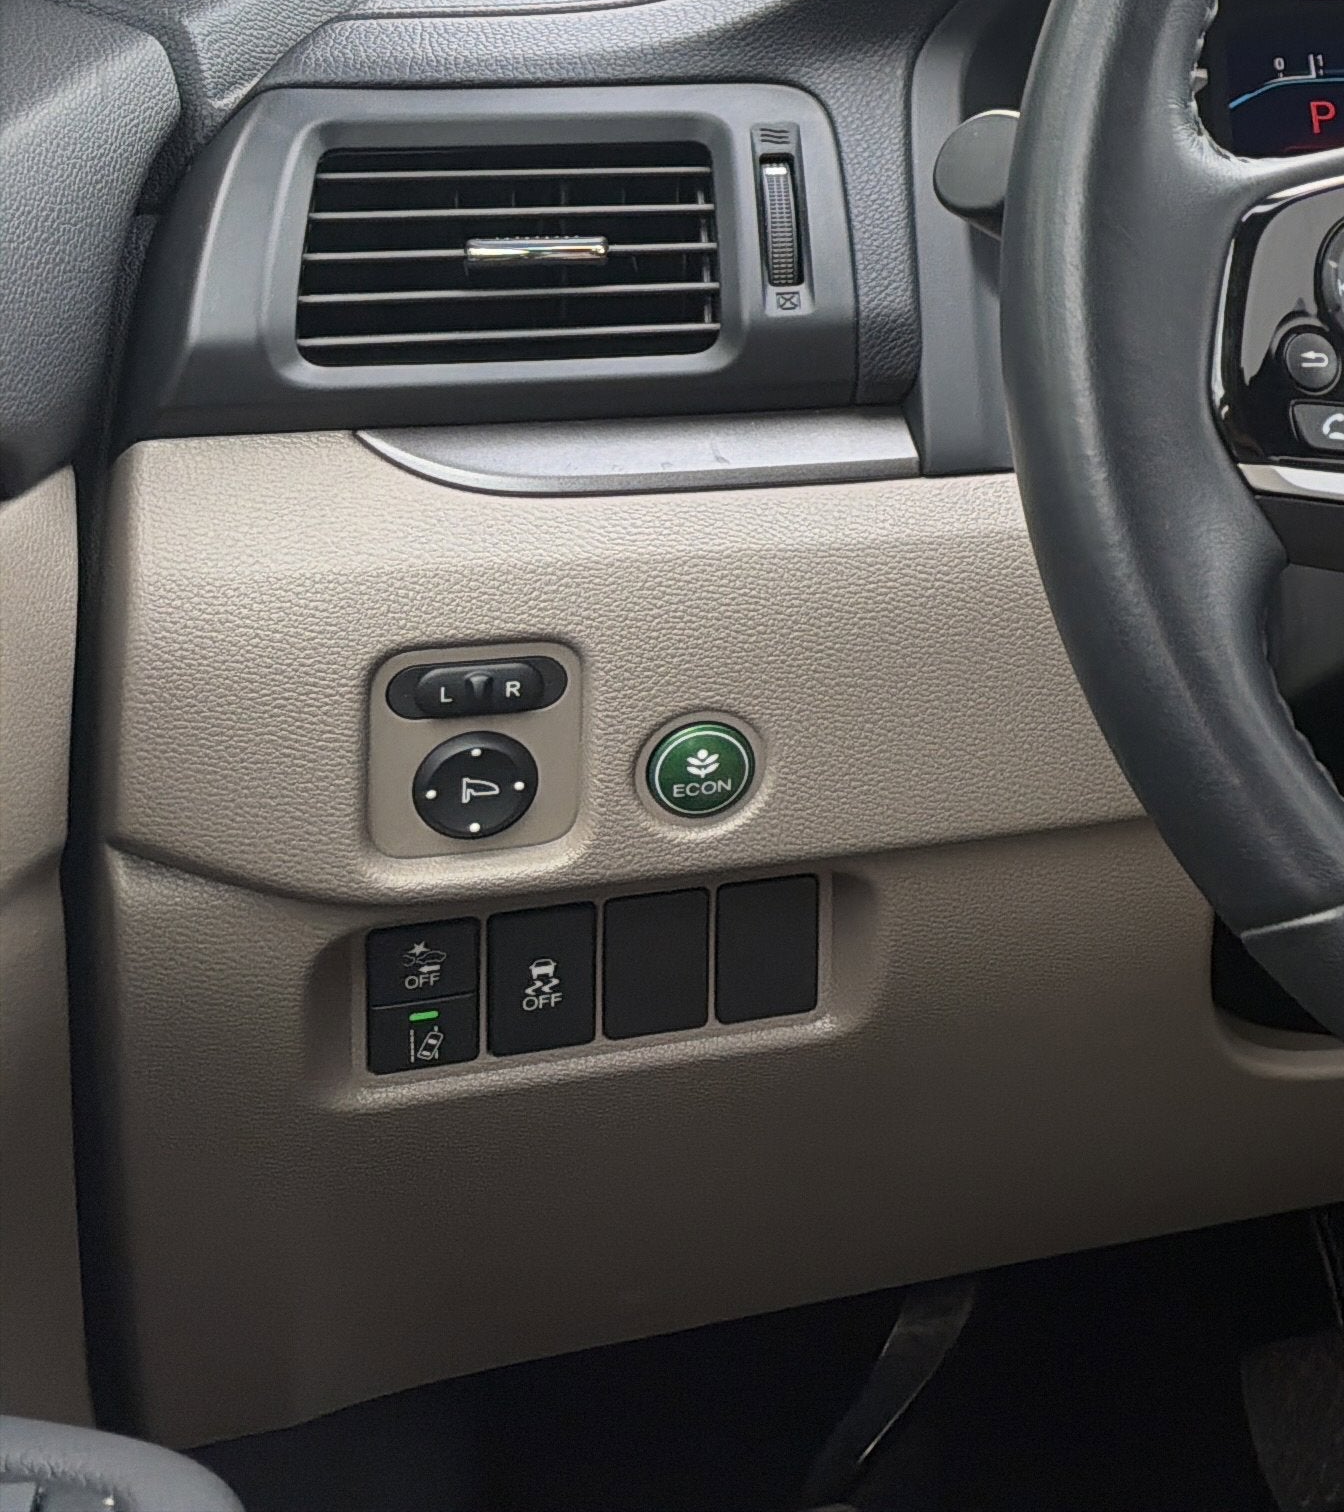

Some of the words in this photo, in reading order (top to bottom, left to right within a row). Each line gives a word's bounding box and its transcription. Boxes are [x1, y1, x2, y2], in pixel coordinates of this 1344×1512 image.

[1273, 56, 1287, 71] 0
[1316, 52, 1325, 67] 1
[1309, 99, 1337, 135] P
[440, 687, 453, 704] L
[506, 681, 522, 698] R
[672, 777, 734, 799] ECON
[404, 973, 442, 991] OFF
[522, 993, 564, 1011] OFF
